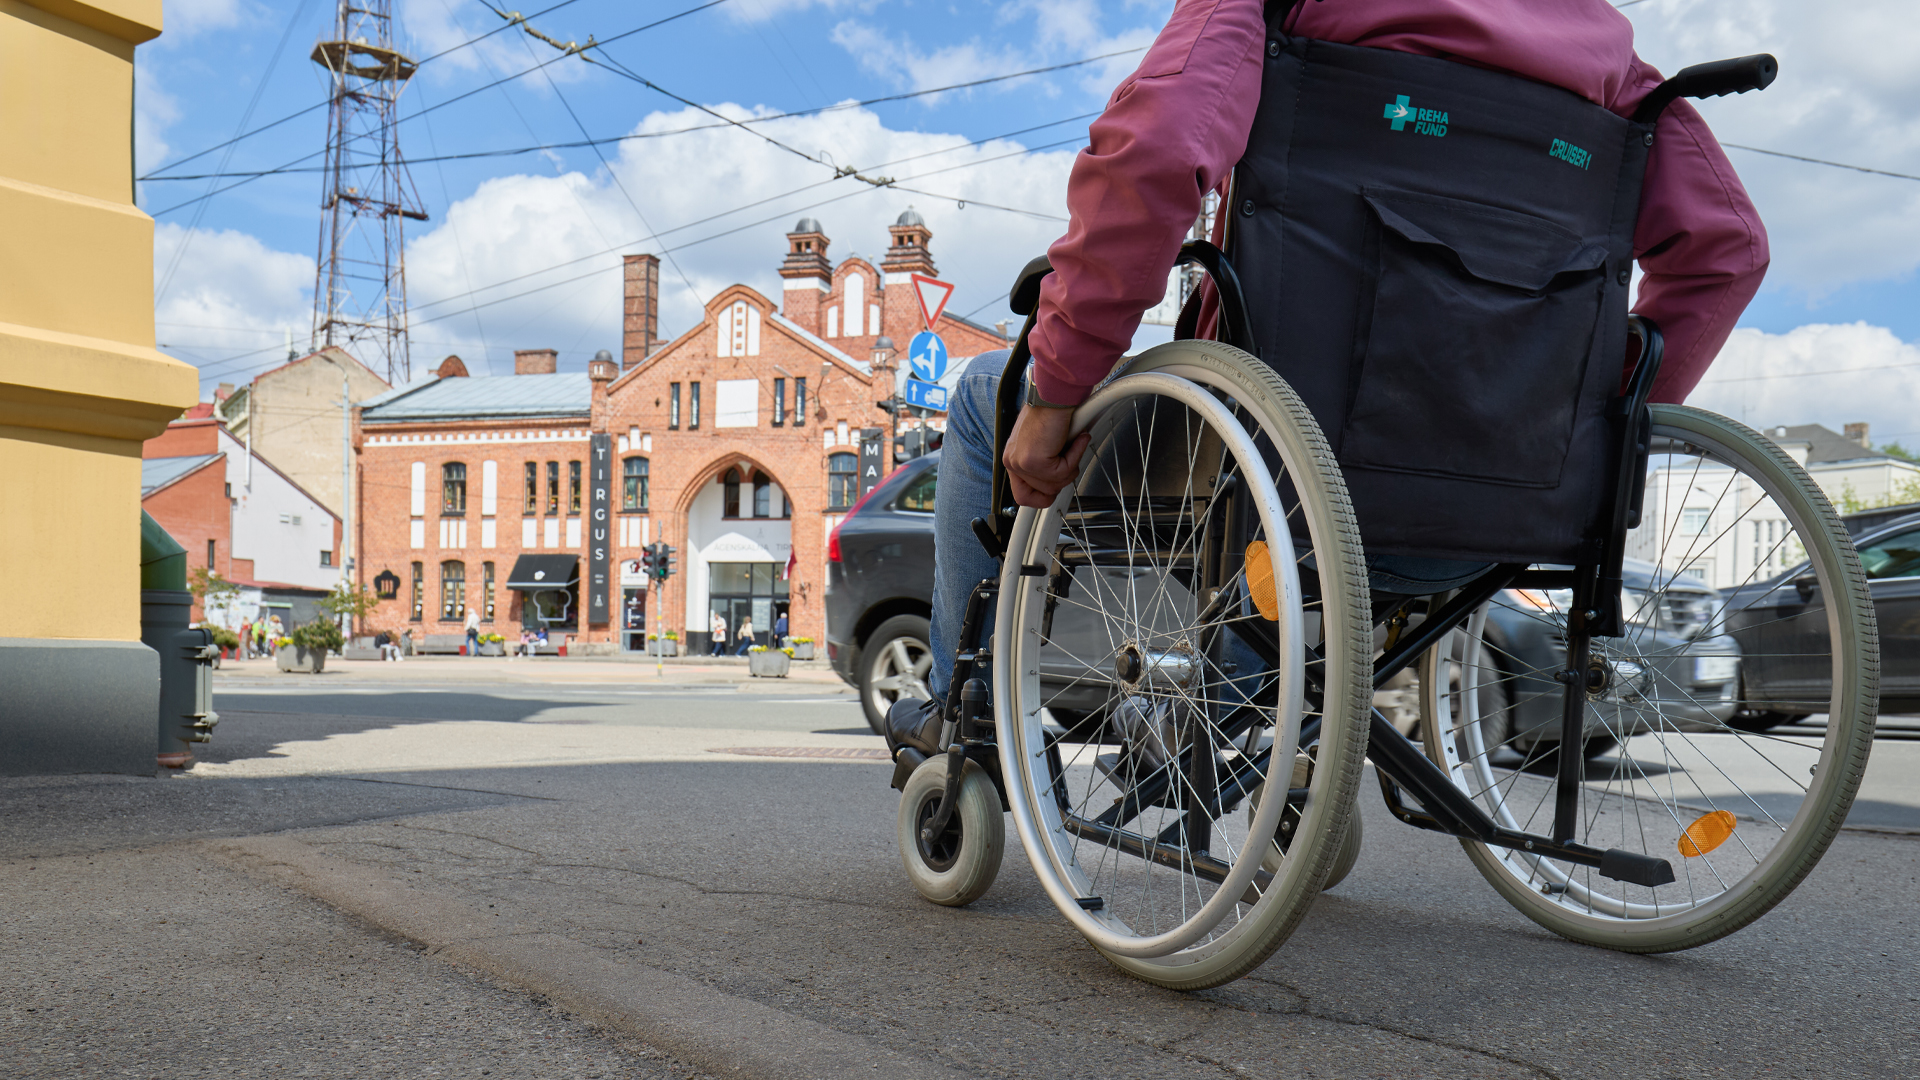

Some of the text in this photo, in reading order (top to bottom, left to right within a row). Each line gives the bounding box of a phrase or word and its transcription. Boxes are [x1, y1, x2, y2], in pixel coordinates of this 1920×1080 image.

[1418, 108, 1448, 124] REHA
[1414, 121, 1447, 137] FUND
[1549, 138, 1592, 171] CRUISER 1
[594, 448, 606, 561] TIRGUS
